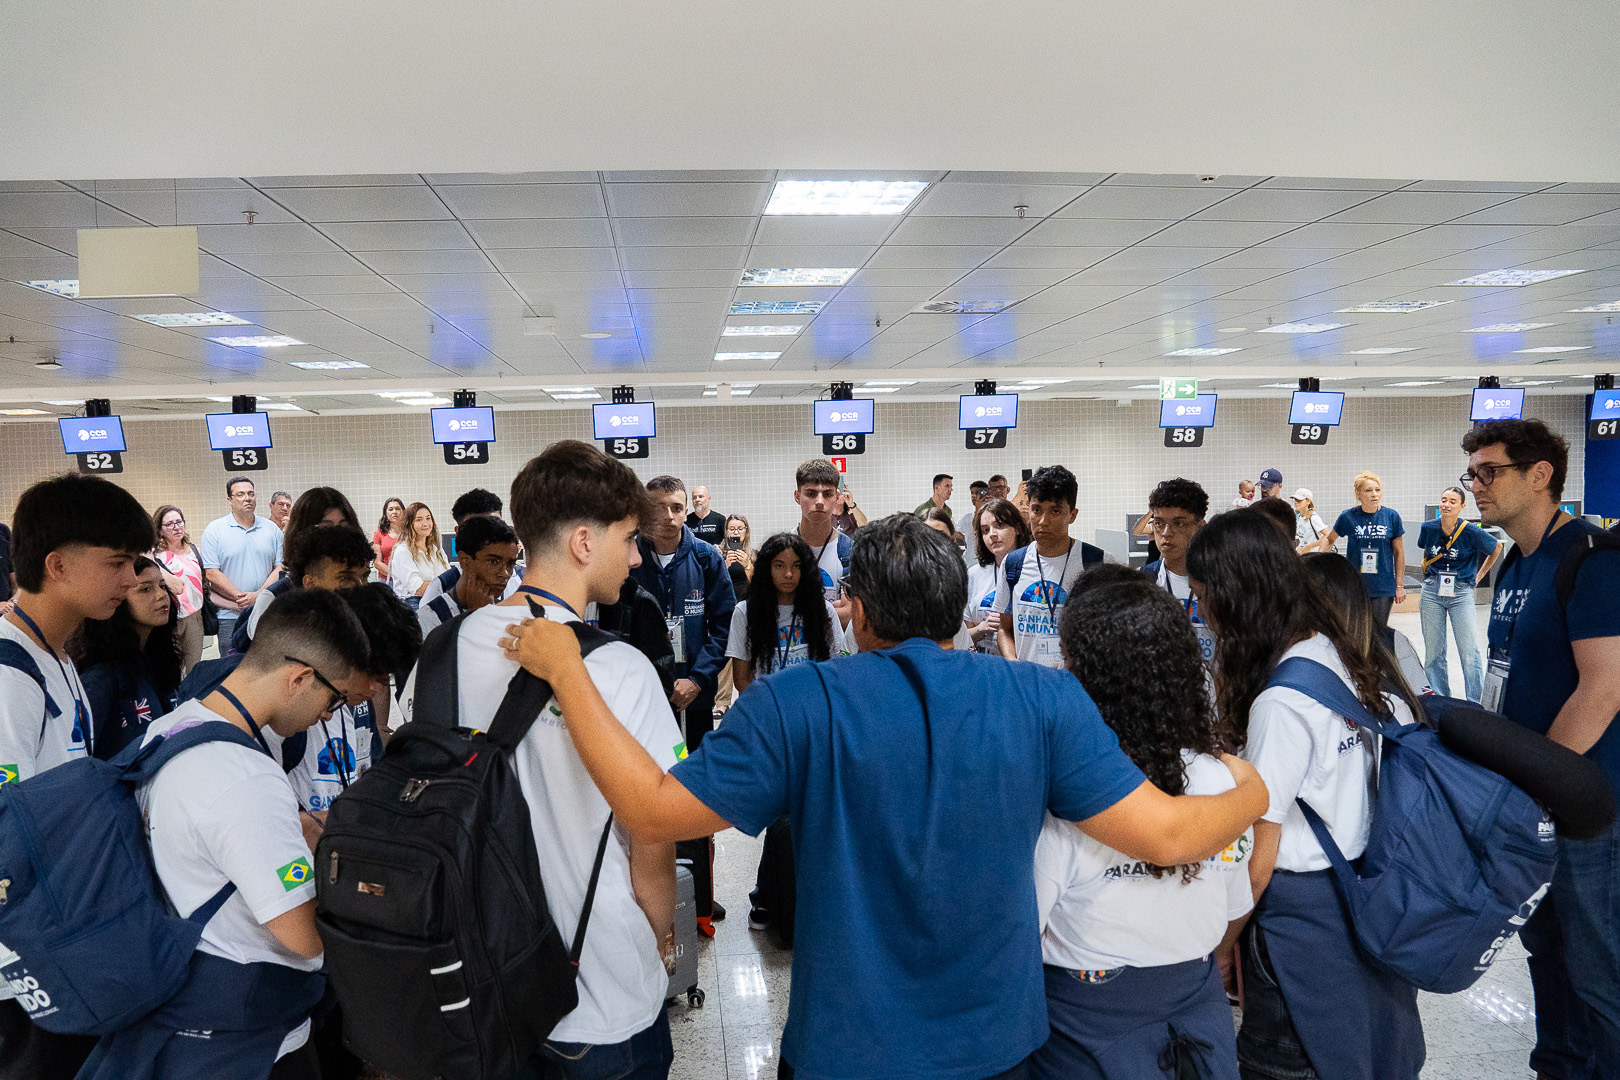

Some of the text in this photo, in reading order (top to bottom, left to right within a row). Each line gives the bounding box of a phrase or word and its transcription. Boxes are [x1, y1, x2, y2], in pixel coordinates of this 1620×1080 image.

[1172, 428, 1196, 443] 58
[1298, 425, 1322, 440] 59
[1597, 421, 1618, 435] 61
[831, 434, 857, 450] 56
[973, 429, 999, 444] 57
[453, 443, 480, 460] 54
[613, 438, 640, 454] 55
[86, 453, 114, 469] 52
[232, 450, 259, 466] 53
[1431, 545, 1459, 558] YS
[1018, 622, 1025, 633] O
